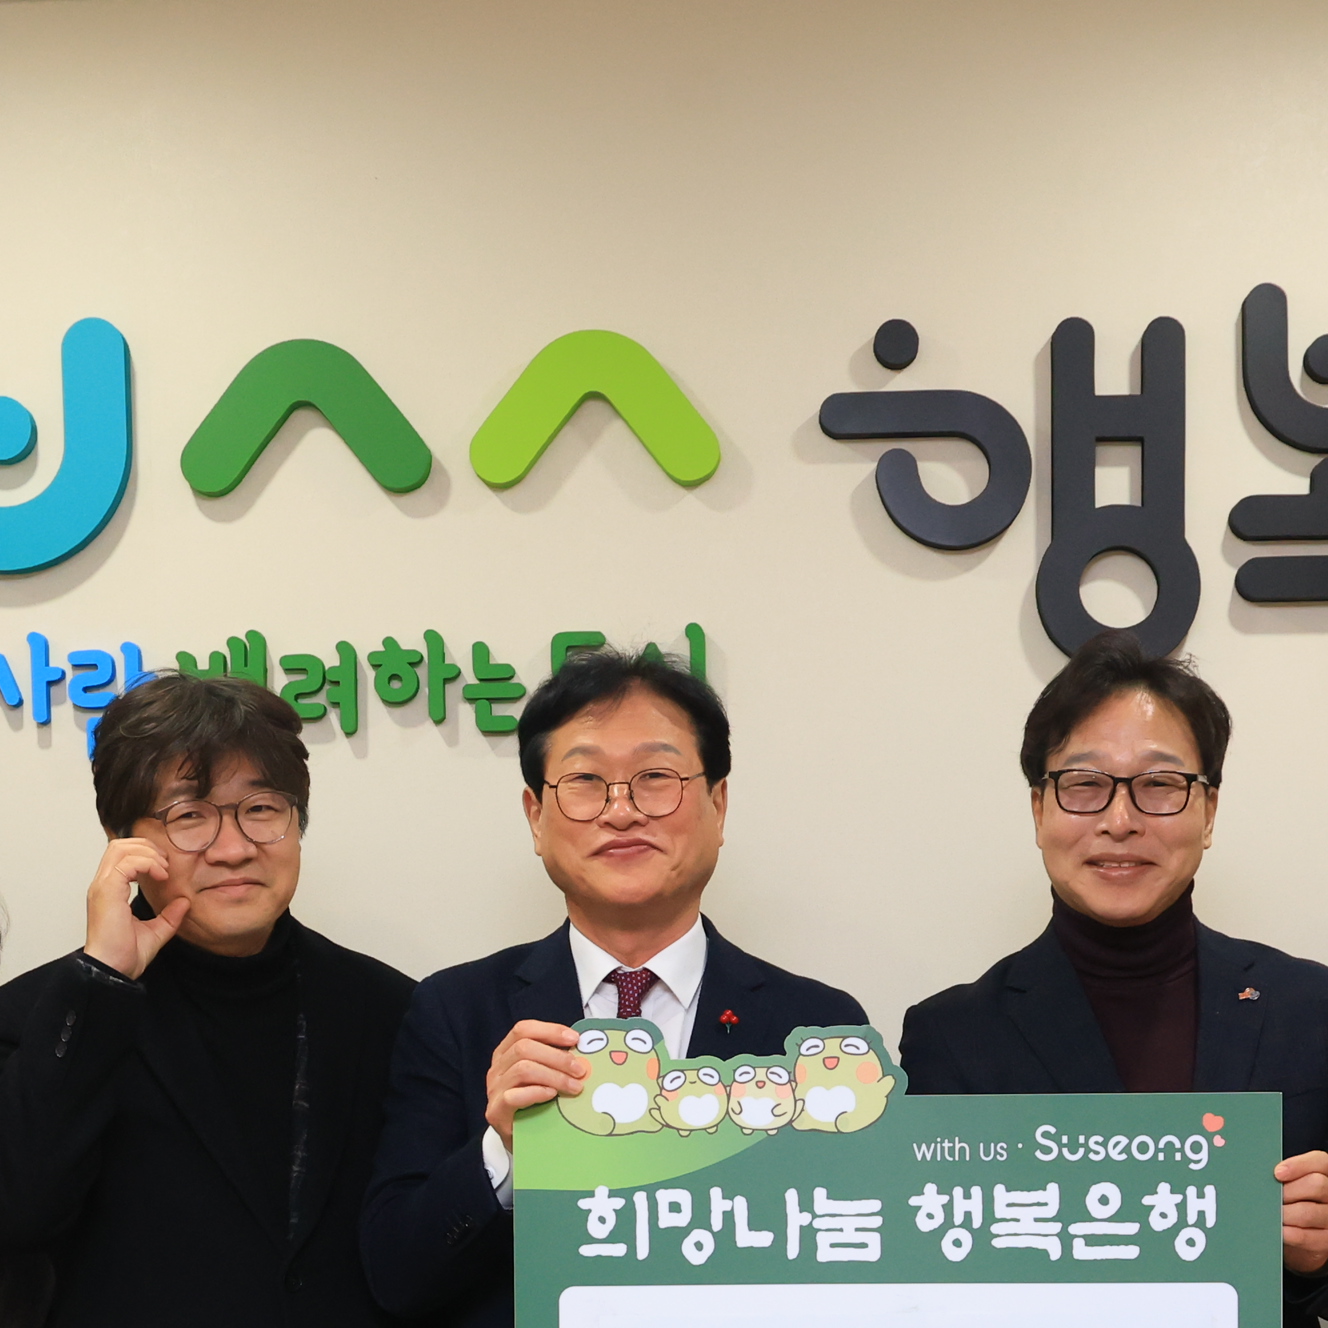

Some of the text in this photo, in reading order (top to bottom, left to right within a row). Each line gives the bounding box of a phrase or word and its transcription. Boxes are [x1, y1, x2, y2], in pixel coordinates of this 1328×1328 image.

[912, 1124, 1210, 1171] with us Suseong
[576, 1181, 1218, 1266] 희망나눔 행복은행
